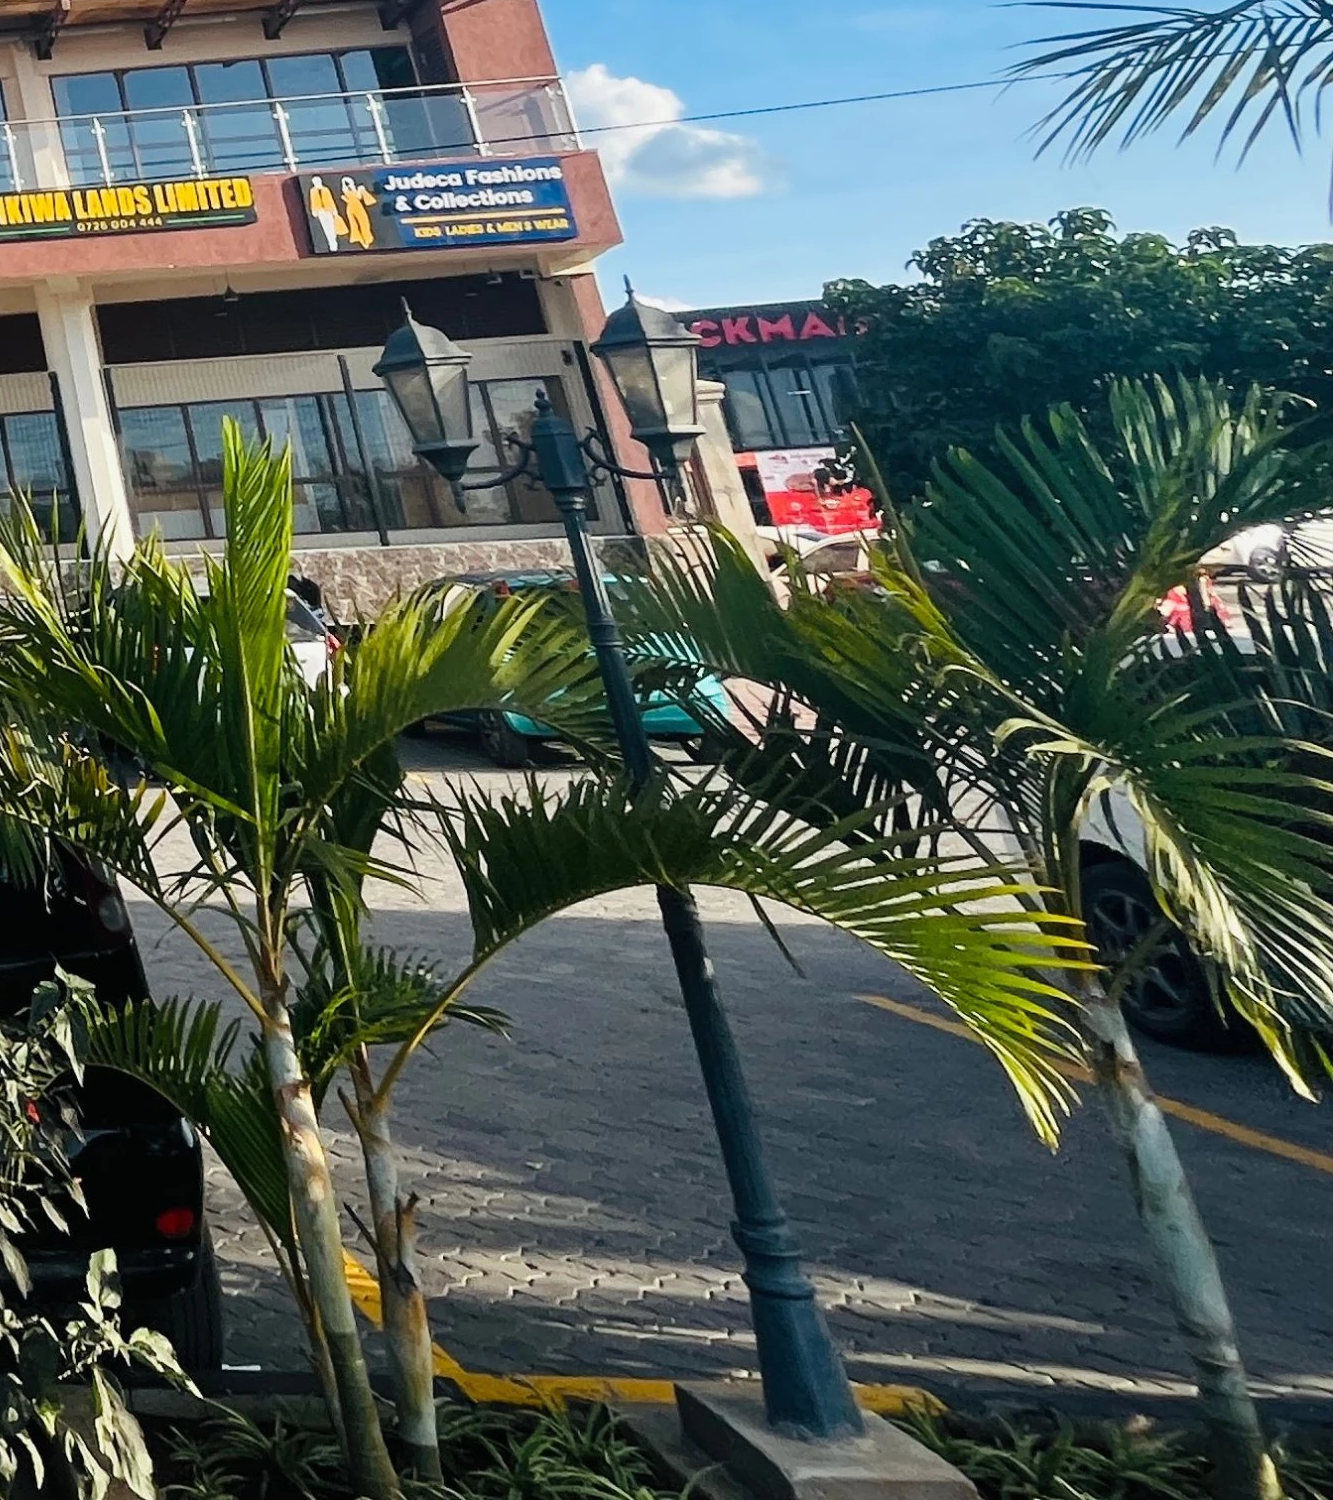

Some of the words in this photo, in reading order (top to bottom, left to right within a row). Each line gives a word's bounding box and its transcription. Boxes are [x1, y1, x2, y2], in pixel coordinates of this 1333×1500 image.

[384, 172, 463, 191] Judeca
[465, 165, 563, 186] Fashions
[72, 185, 152, 220] LANDS
[152, 177, 254, 214] LIMITED
[395, 195, 412, 211] &
[413, 189, 534, 210] Collections
[486, 223, 496, 234] &
